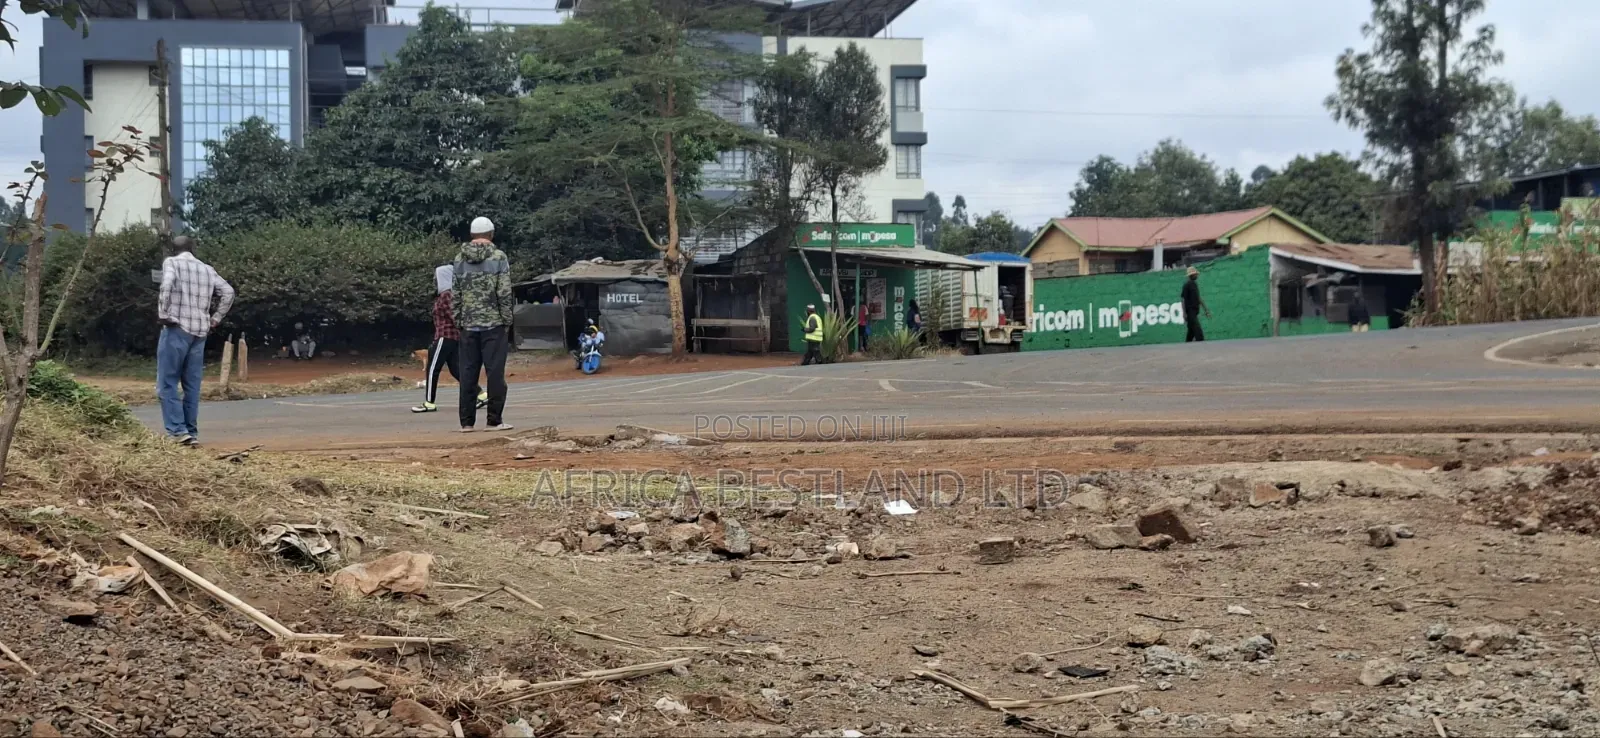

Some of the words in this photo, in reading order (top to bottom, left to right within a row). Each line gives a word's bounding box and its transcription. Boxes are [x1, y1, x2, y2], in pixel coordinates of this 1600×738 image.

[811, 231, 857, 241] Safacom
[607, 293, 643, 304] HOTEL
[1030, 304, 1085, 335] ricom
